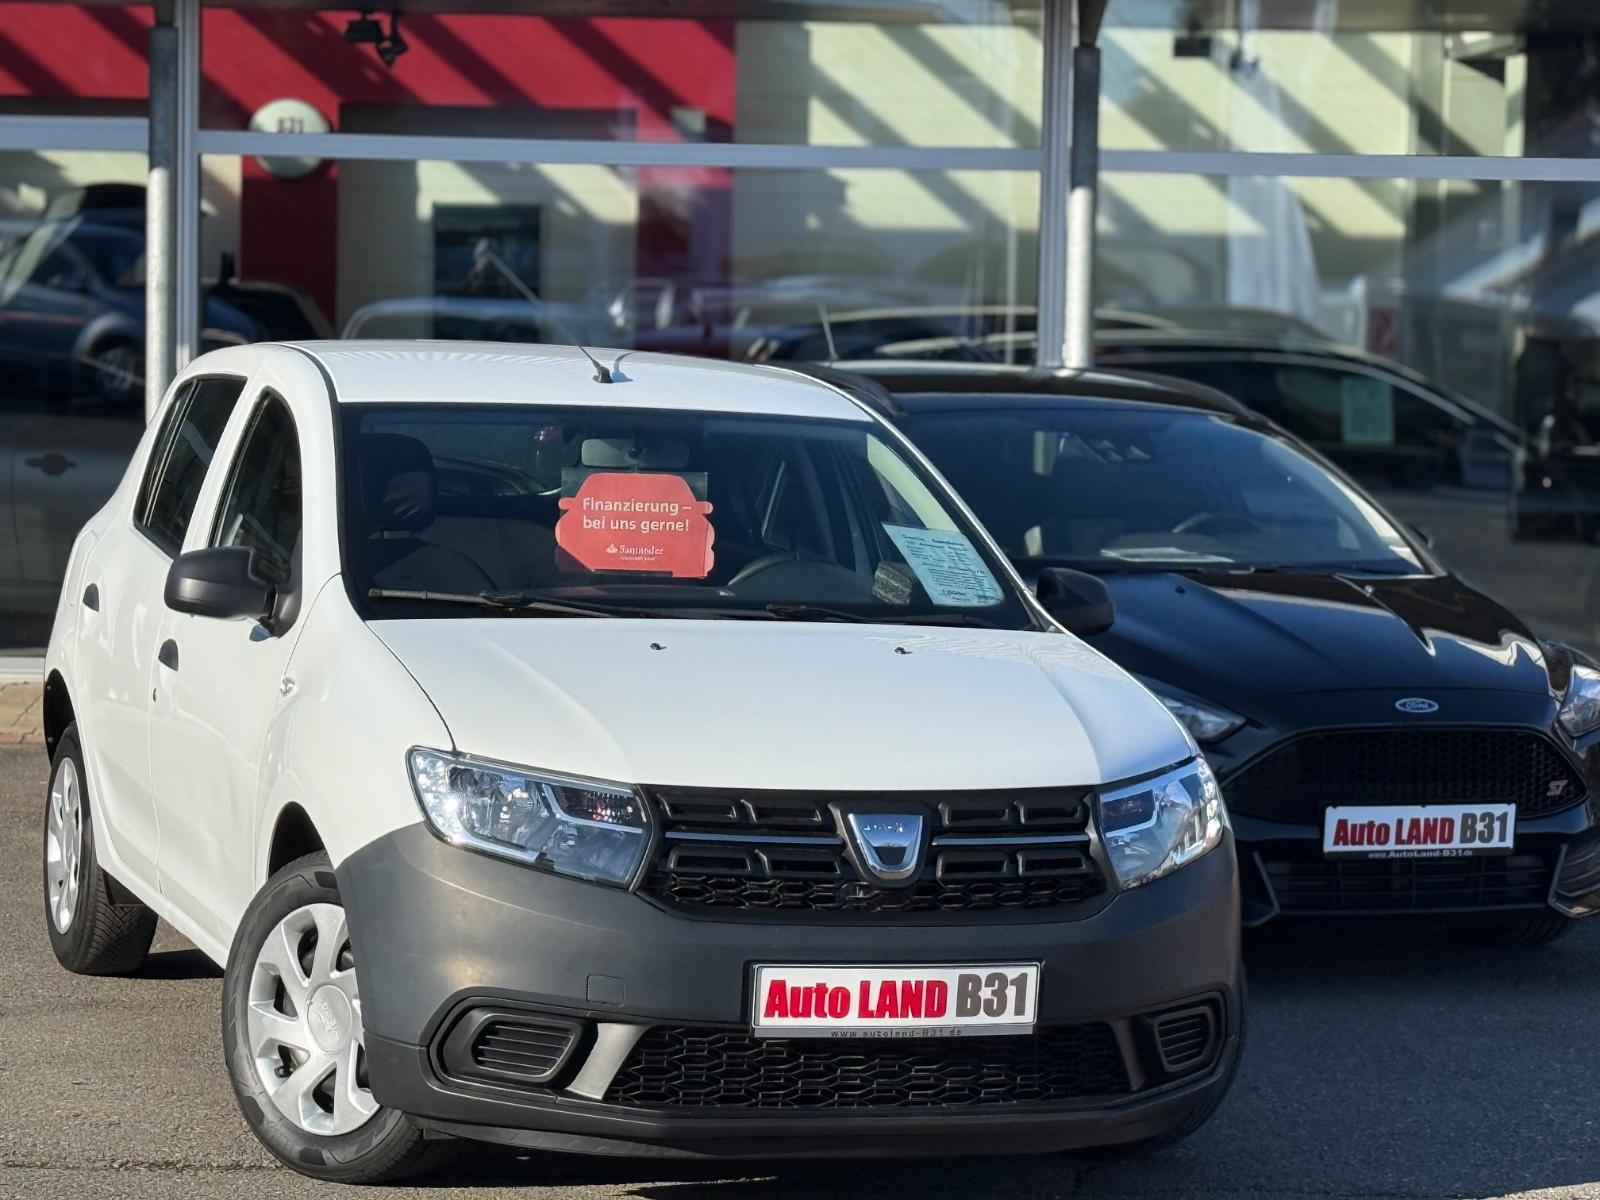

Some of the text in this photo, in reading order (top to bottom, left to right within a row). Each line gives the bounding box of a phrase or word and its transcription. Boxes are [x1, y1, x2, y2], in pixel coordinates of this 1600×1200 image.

[583, 497, 679, 516] Finanzierung
[583, 515, 689, 534] bei uns gerne!
[619, 544, 664, 555] Santander
[1333, 811, 1509, 846] Auto LAND B31
[763, 972, 1029, 1019] Auto LAND B31
